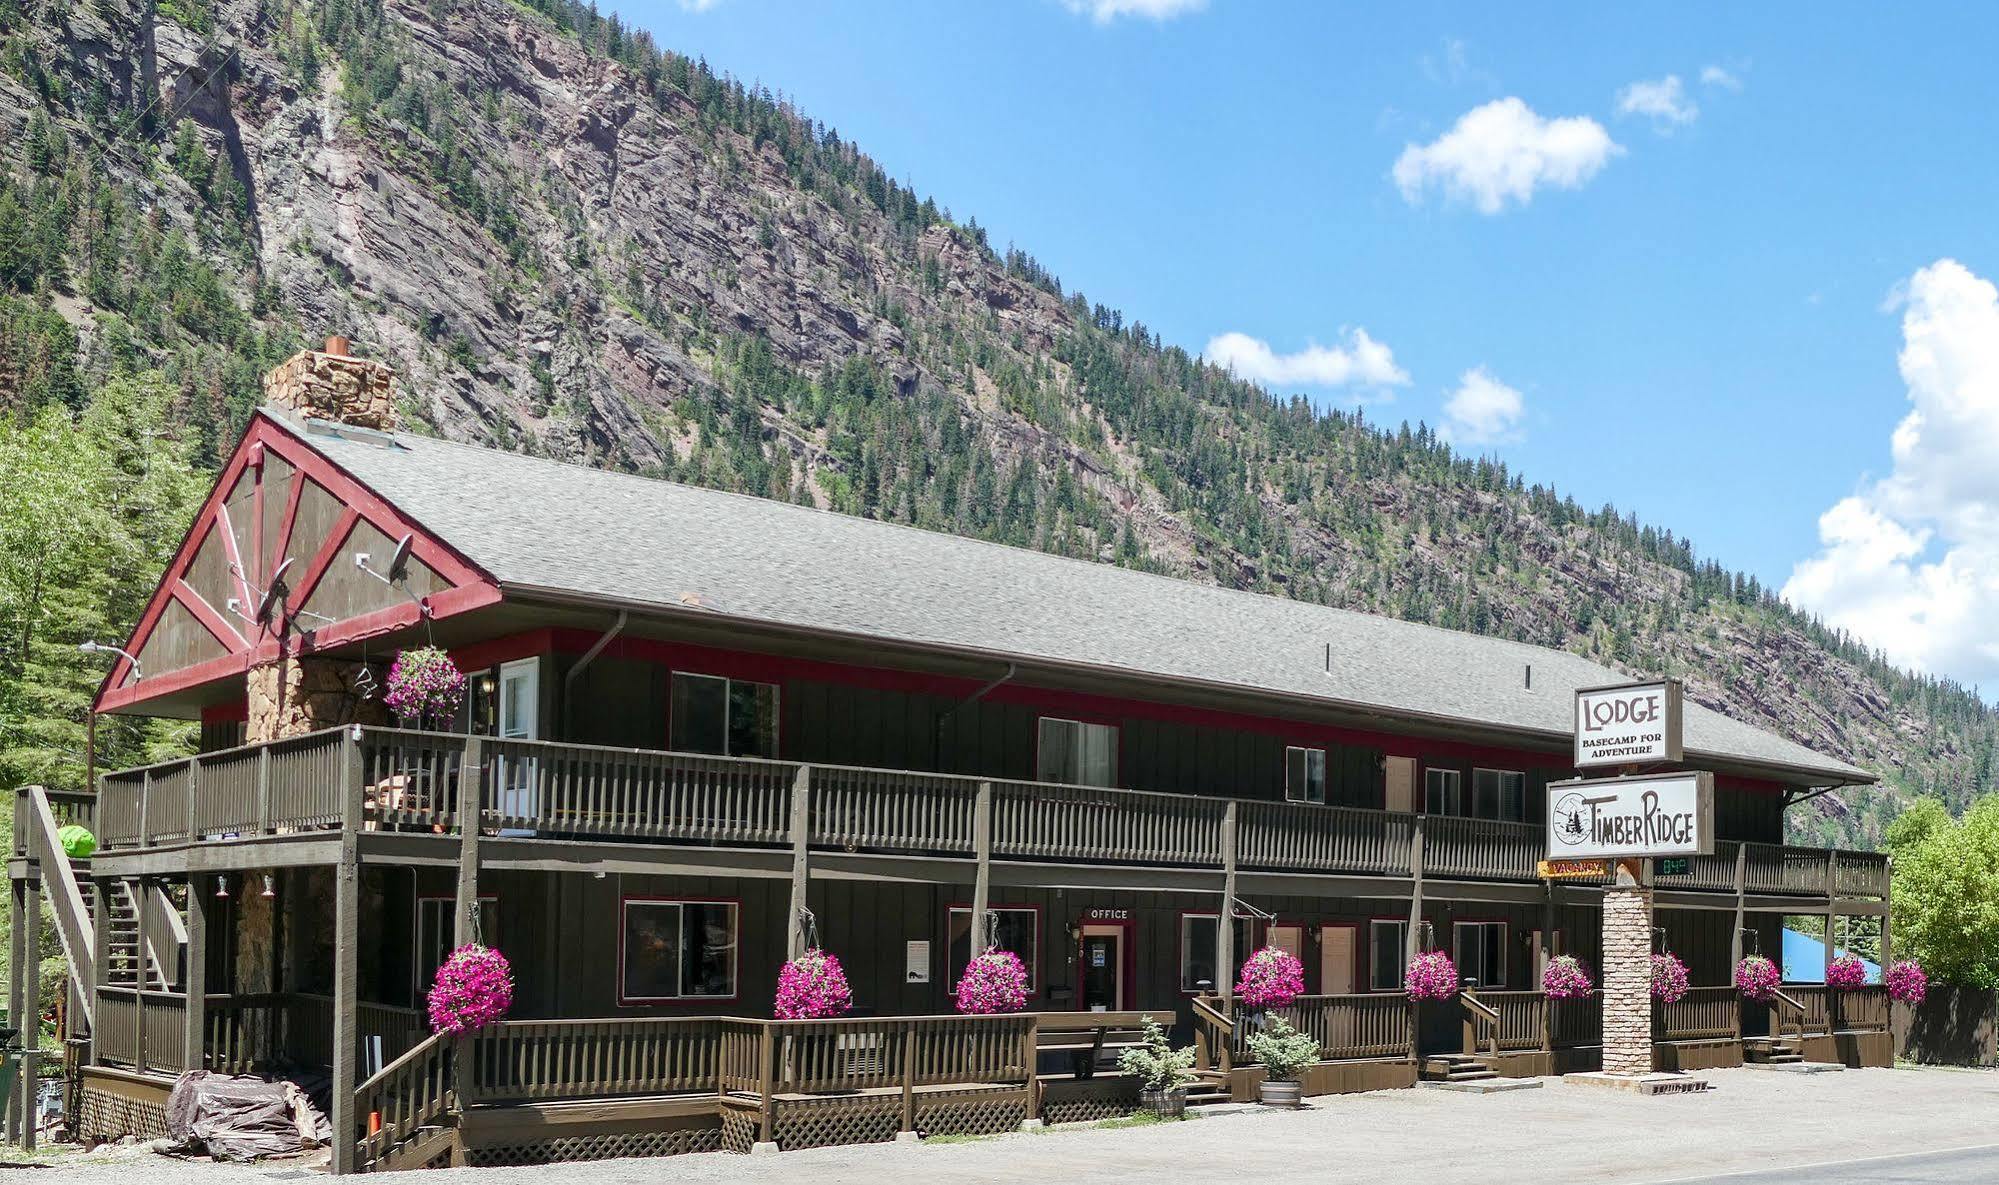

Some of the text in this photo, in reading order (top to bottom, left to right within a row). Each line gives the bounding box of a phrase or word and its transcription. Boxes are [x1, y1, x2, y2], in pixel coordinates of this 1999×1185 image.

[1584, 696, 1660, 731] LODGE
[1582, 733, 1662, 748] BASECAMP FOR
[1591, 745, 1653, 758] ADVENTURE
[1553, 862, 1600, 874] VACANCY
[1091, 909, 1128, 919] OFFICE
